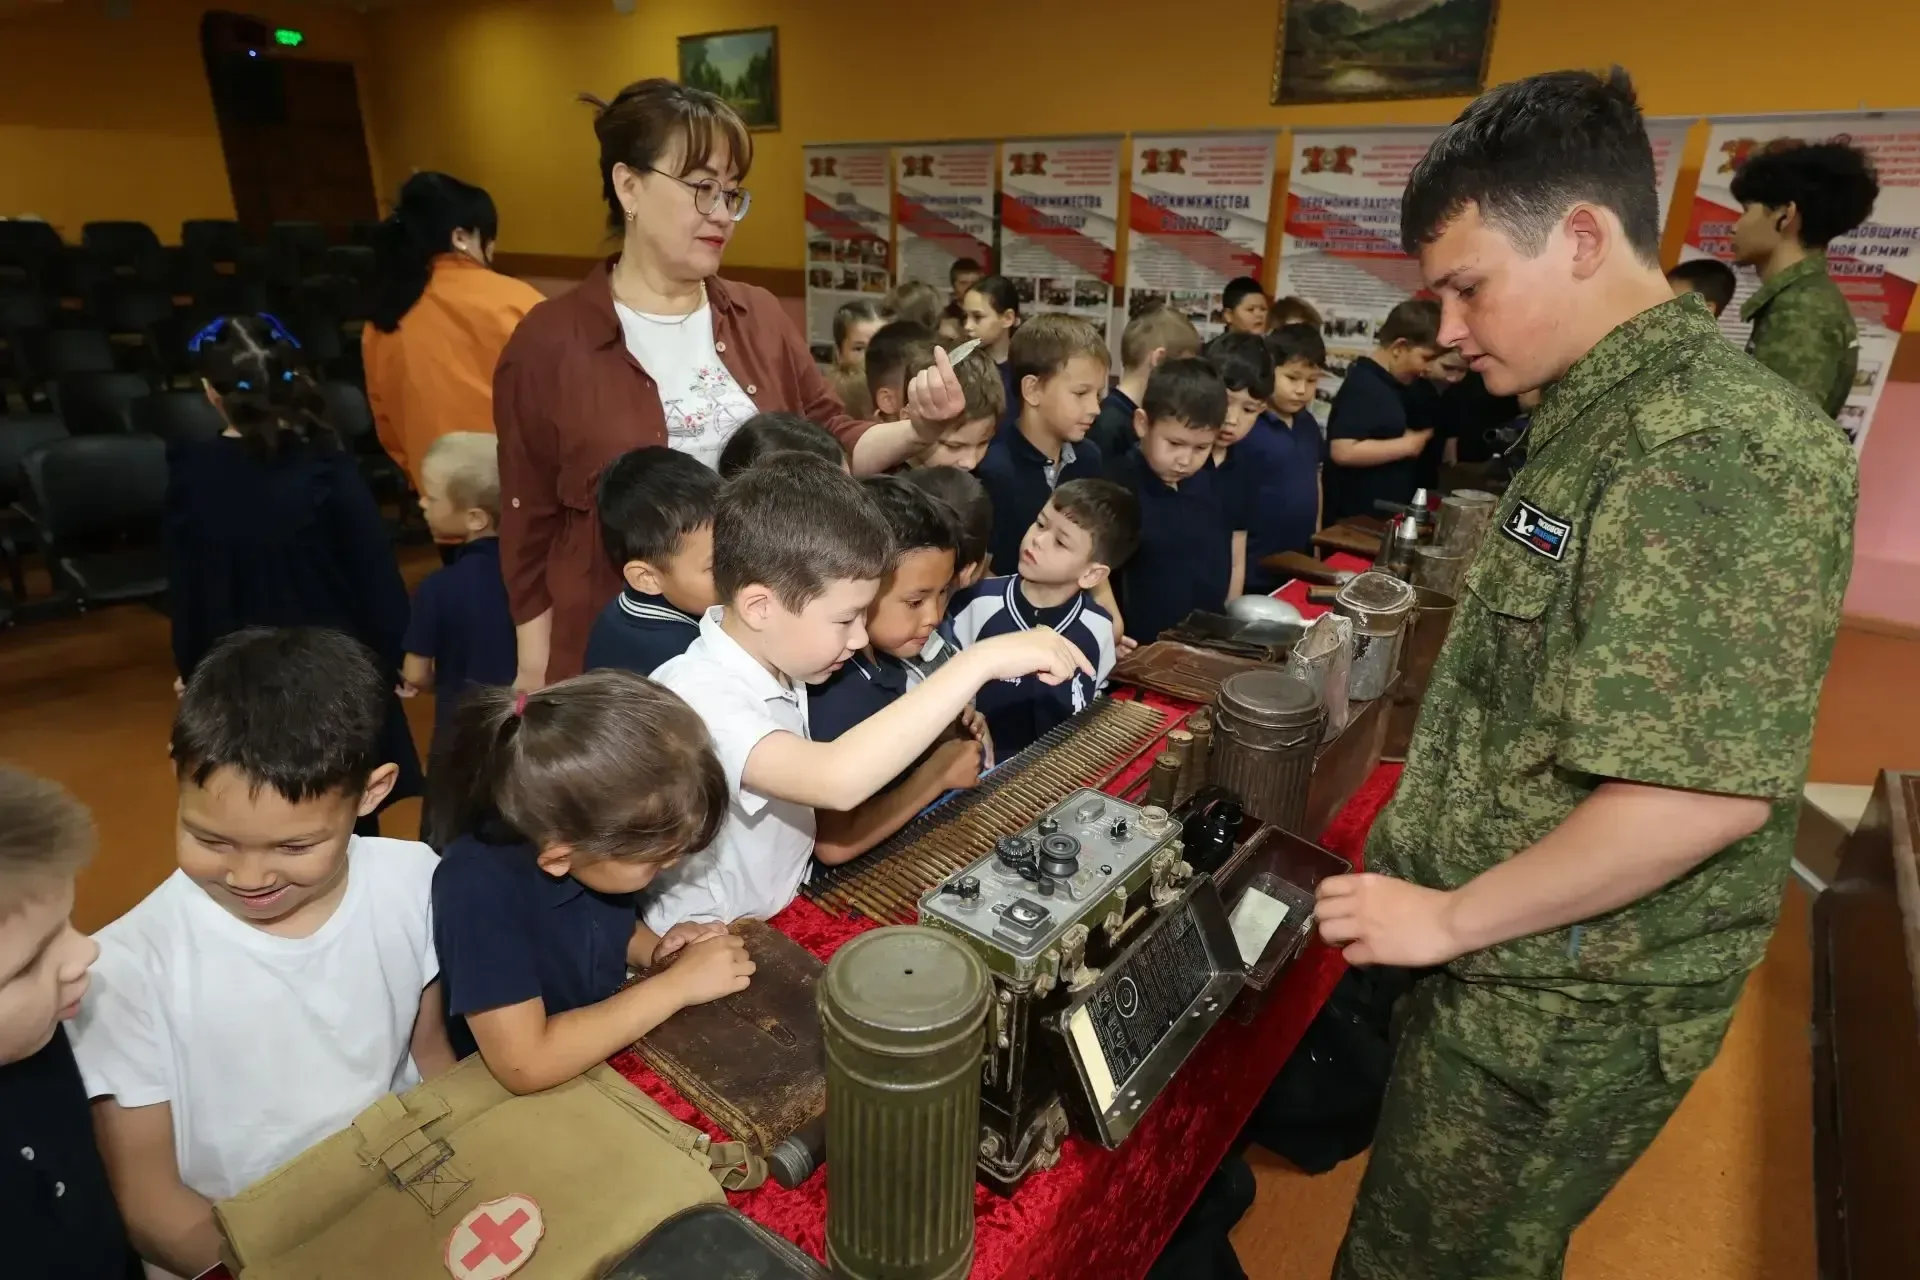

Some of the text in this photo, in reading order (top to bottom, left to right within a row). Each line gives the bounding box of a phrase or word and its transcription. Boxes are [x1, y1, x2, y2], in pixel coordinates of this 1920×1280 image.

[1203, 216, 1231, 231] ГОДУ
[1849, 226, 1920, 240] ДОВЩИНЕ
[1830, 244, 1857, 256] НОЙ
[1860, 244, 1910, 258] АРМИИ
[1831, 262, 1885, 275] МЫКИЯ
